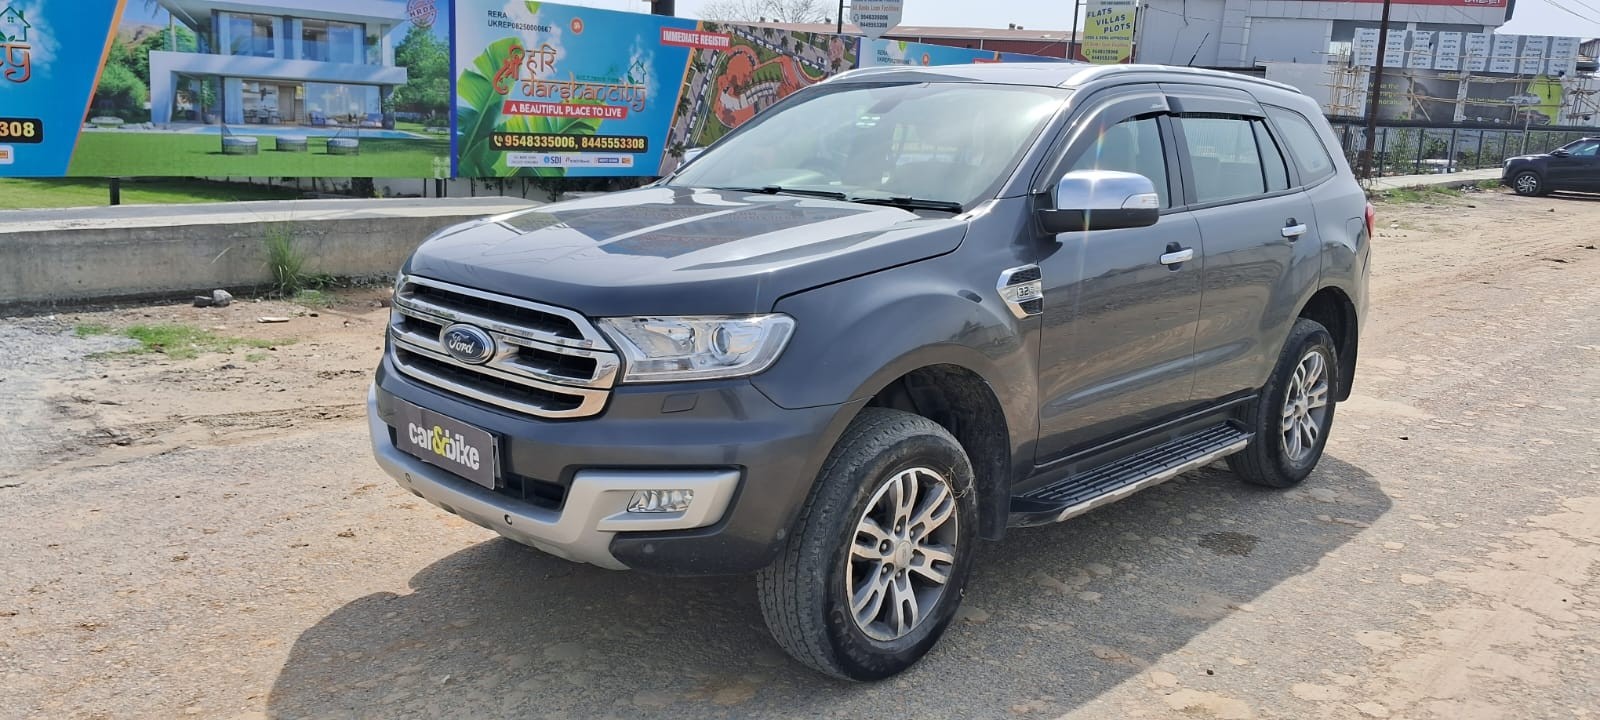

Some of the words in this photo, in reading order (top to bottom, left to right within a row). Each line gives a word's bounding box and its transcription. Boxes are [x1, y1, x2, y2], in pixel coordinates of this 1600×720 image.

[487, 10, 508, 19] RERA
[1087, 7, 1112, 18] FLATS
[1096, 14, 1126, 26] VILLAS
[1103, 22, 1131, 33] PLOTS
[663, 30, 699, 45] IMMEDIATE
[700, 34, 730, 47] REGISTRY
[510, 103, 517, 113] A
[520, 104, 563, 115] BEAUTIFUL
[565, 106, 590, 116] PLACE
[591, 108, 604, 117] TO
[605, 109, 622, 117] LIVE
[504, 134, 579, 149] 9548335006,
[581, 137, 645, 149] 8445553308
[449, 331, 474, 354] Ford
[408, 422, 480, 470] car&bike
